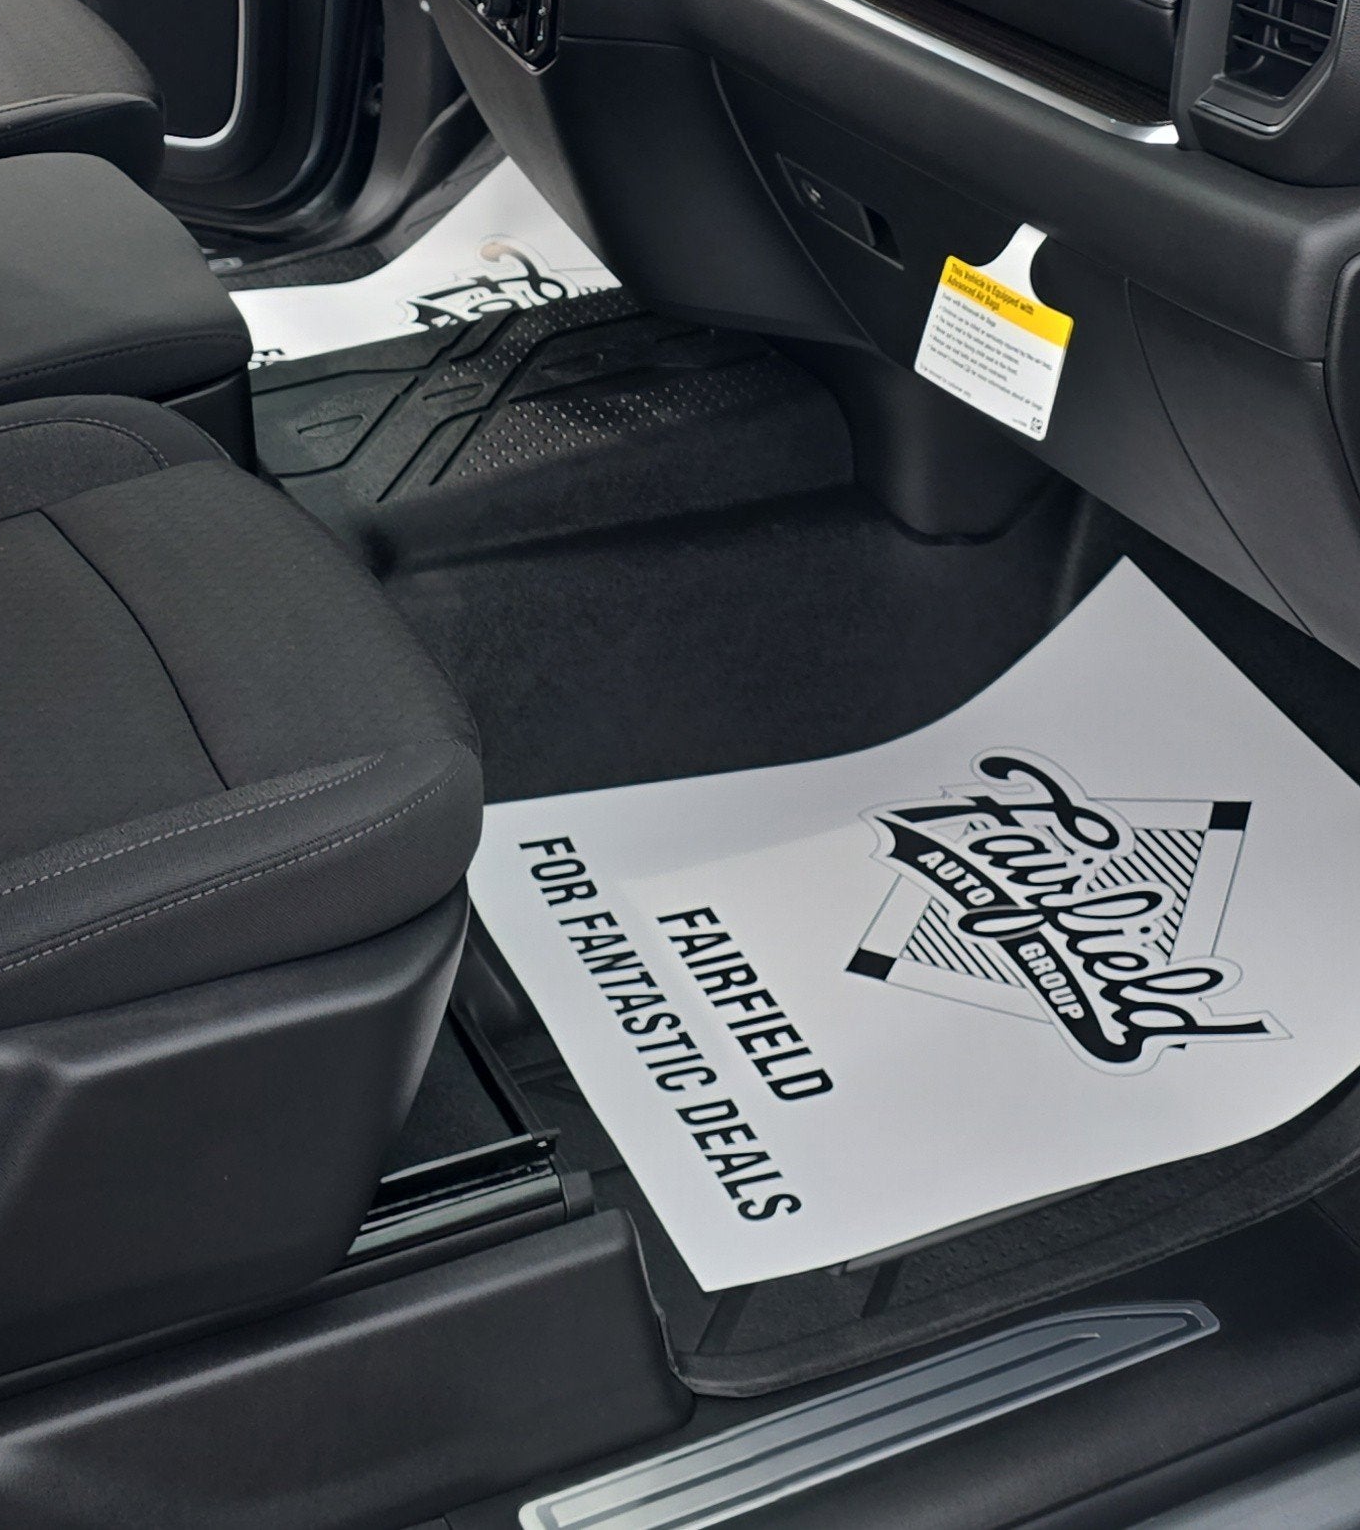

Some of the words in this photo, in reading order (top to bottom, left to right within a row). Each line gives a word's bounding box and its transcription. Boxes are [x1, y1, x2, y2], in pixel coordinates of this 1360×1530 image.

[946, 274, 976, 296] Advanced
[976, 289, 985, 301] Air
[983, 294, 1000, 312] Bags
[950, 263, 964, 277] This
[964, 271, 986, 289] Vehicle
[991, 285, 1020, 309] Equipped
[1019, 300, 1035, 315] with
[890, 756, 1271, 1042] Fairfield
[917, 850, 996, 907] AUTO
[656, 906, 834, 1101] FAIRFIELD
[1018, 941, 1085, 1021] GROUP
[518, 836, 598, 907] FOR
[558, 911, 718, 1092] FANTASTIC
[675, 1098, 802, 1221] DEALS
